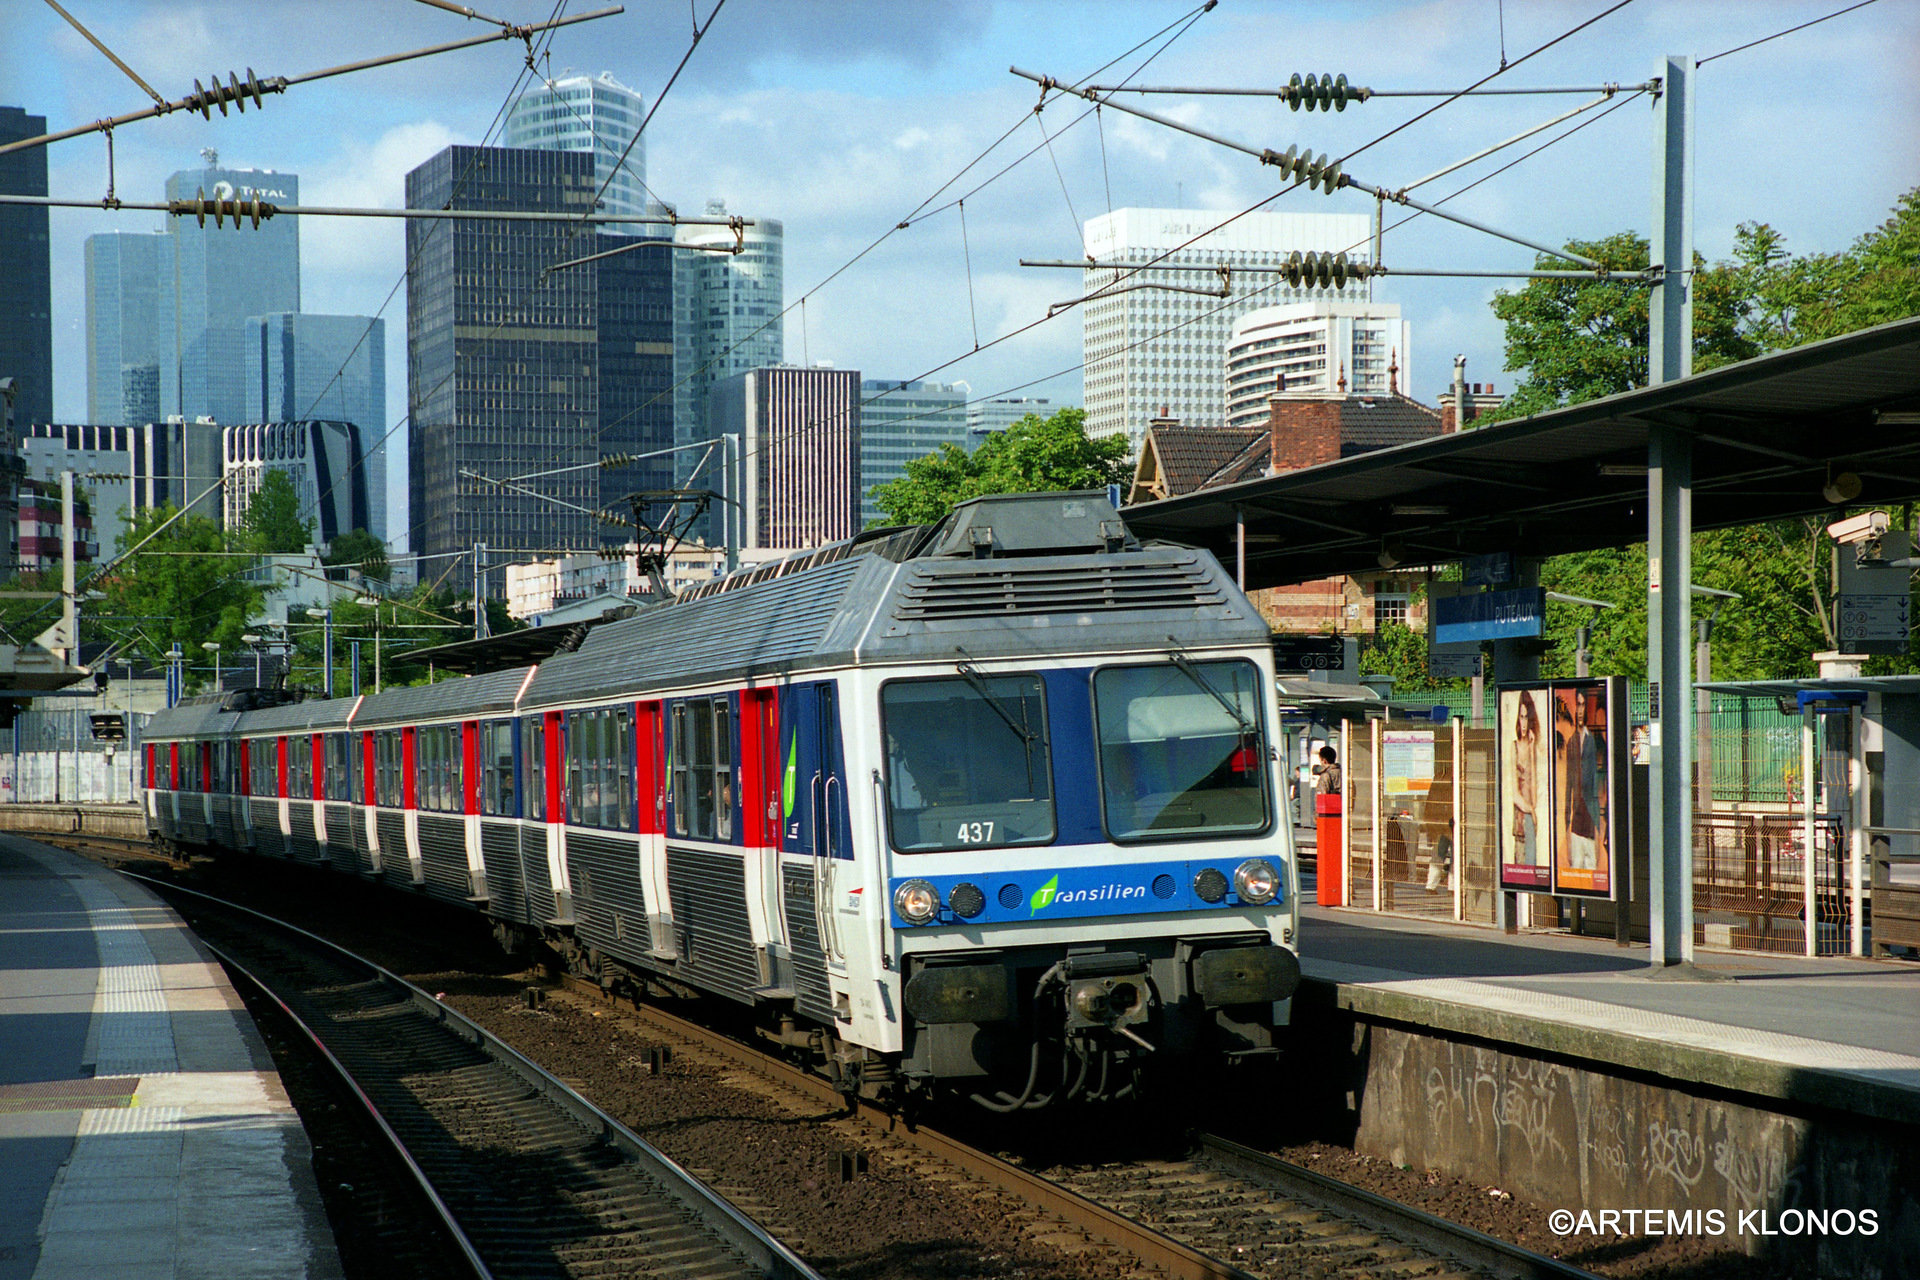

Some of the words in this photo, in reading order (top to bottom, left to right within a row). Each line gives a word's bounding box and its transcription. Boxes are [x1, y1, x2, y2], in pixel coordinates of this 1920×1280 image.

[1495, 603, 1534, 624] PUTEAUX
[957, 822, 994, 843] 437
[1040, 884, 1145, 904] Transilien
